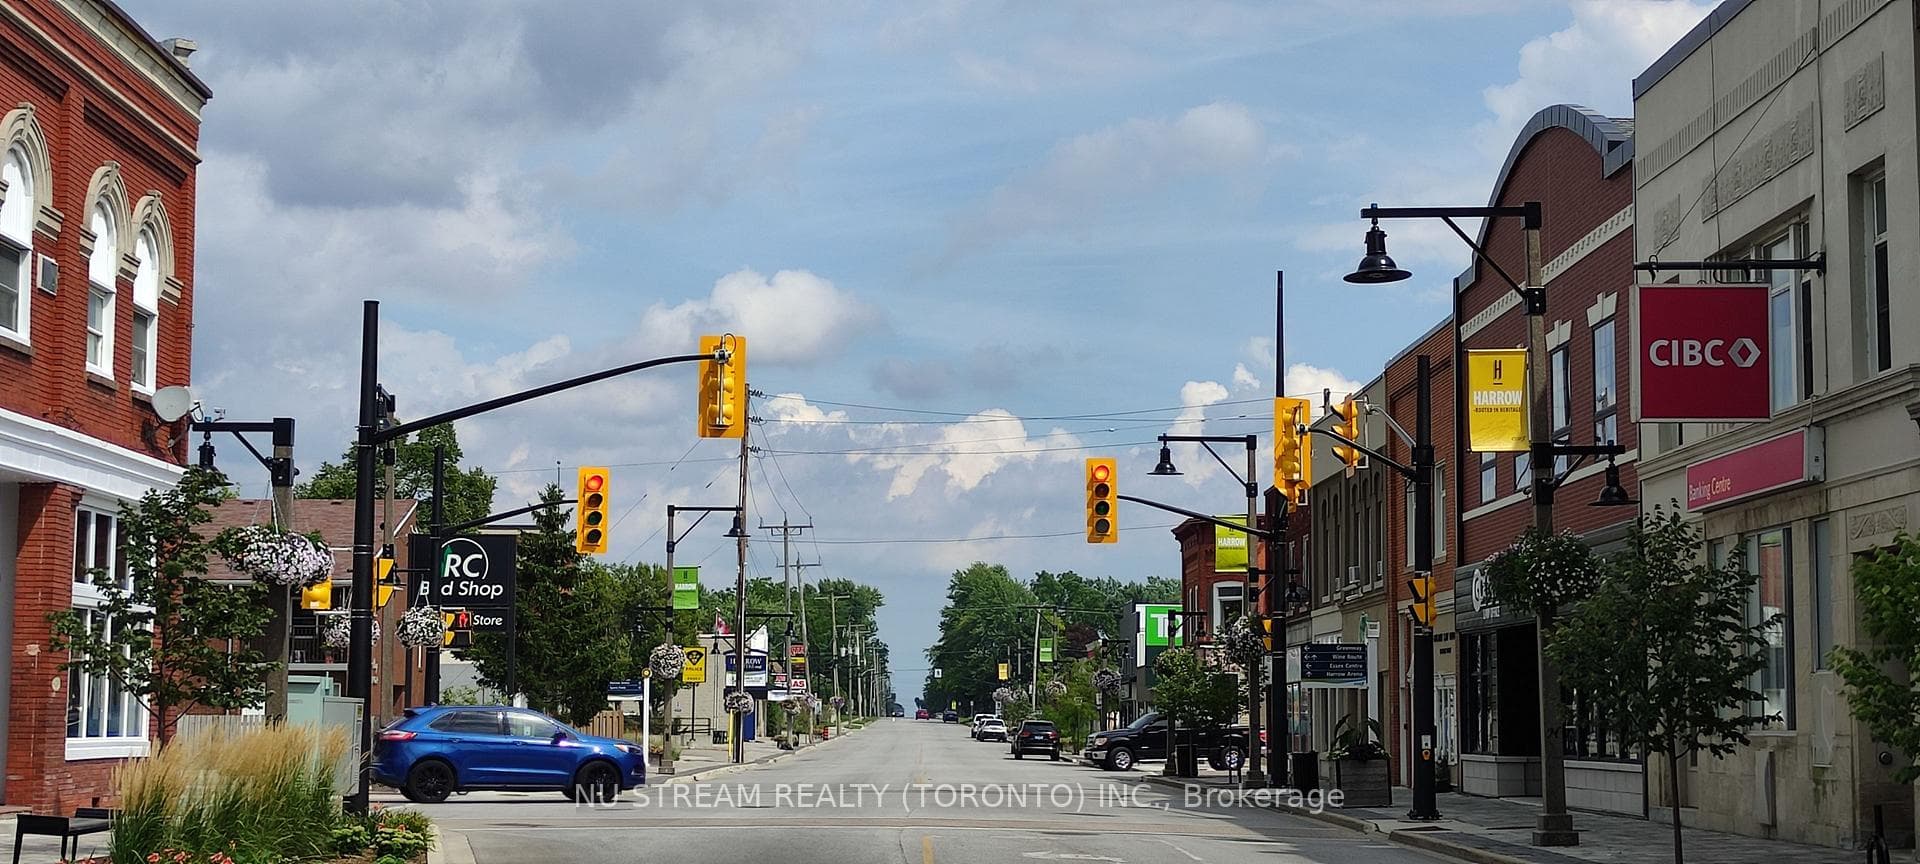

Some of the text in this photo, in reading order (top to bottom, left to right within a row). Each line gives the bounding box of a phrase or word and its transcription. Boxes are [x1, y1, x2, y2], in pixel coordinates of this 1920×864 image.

[1649, 339, 1725, 367] CIBC
[1494, 359, 1502, 379] H
[1473, 390, 1522, 405] HARROW
[1689, 476, 1731, 501] Banking Centre
[1218, 538, 1246, 547] HARROW
[444, 554, 483, 577] RC
[458, 580, 504, 600] Shop
[472, 614, 503, 626] Store
